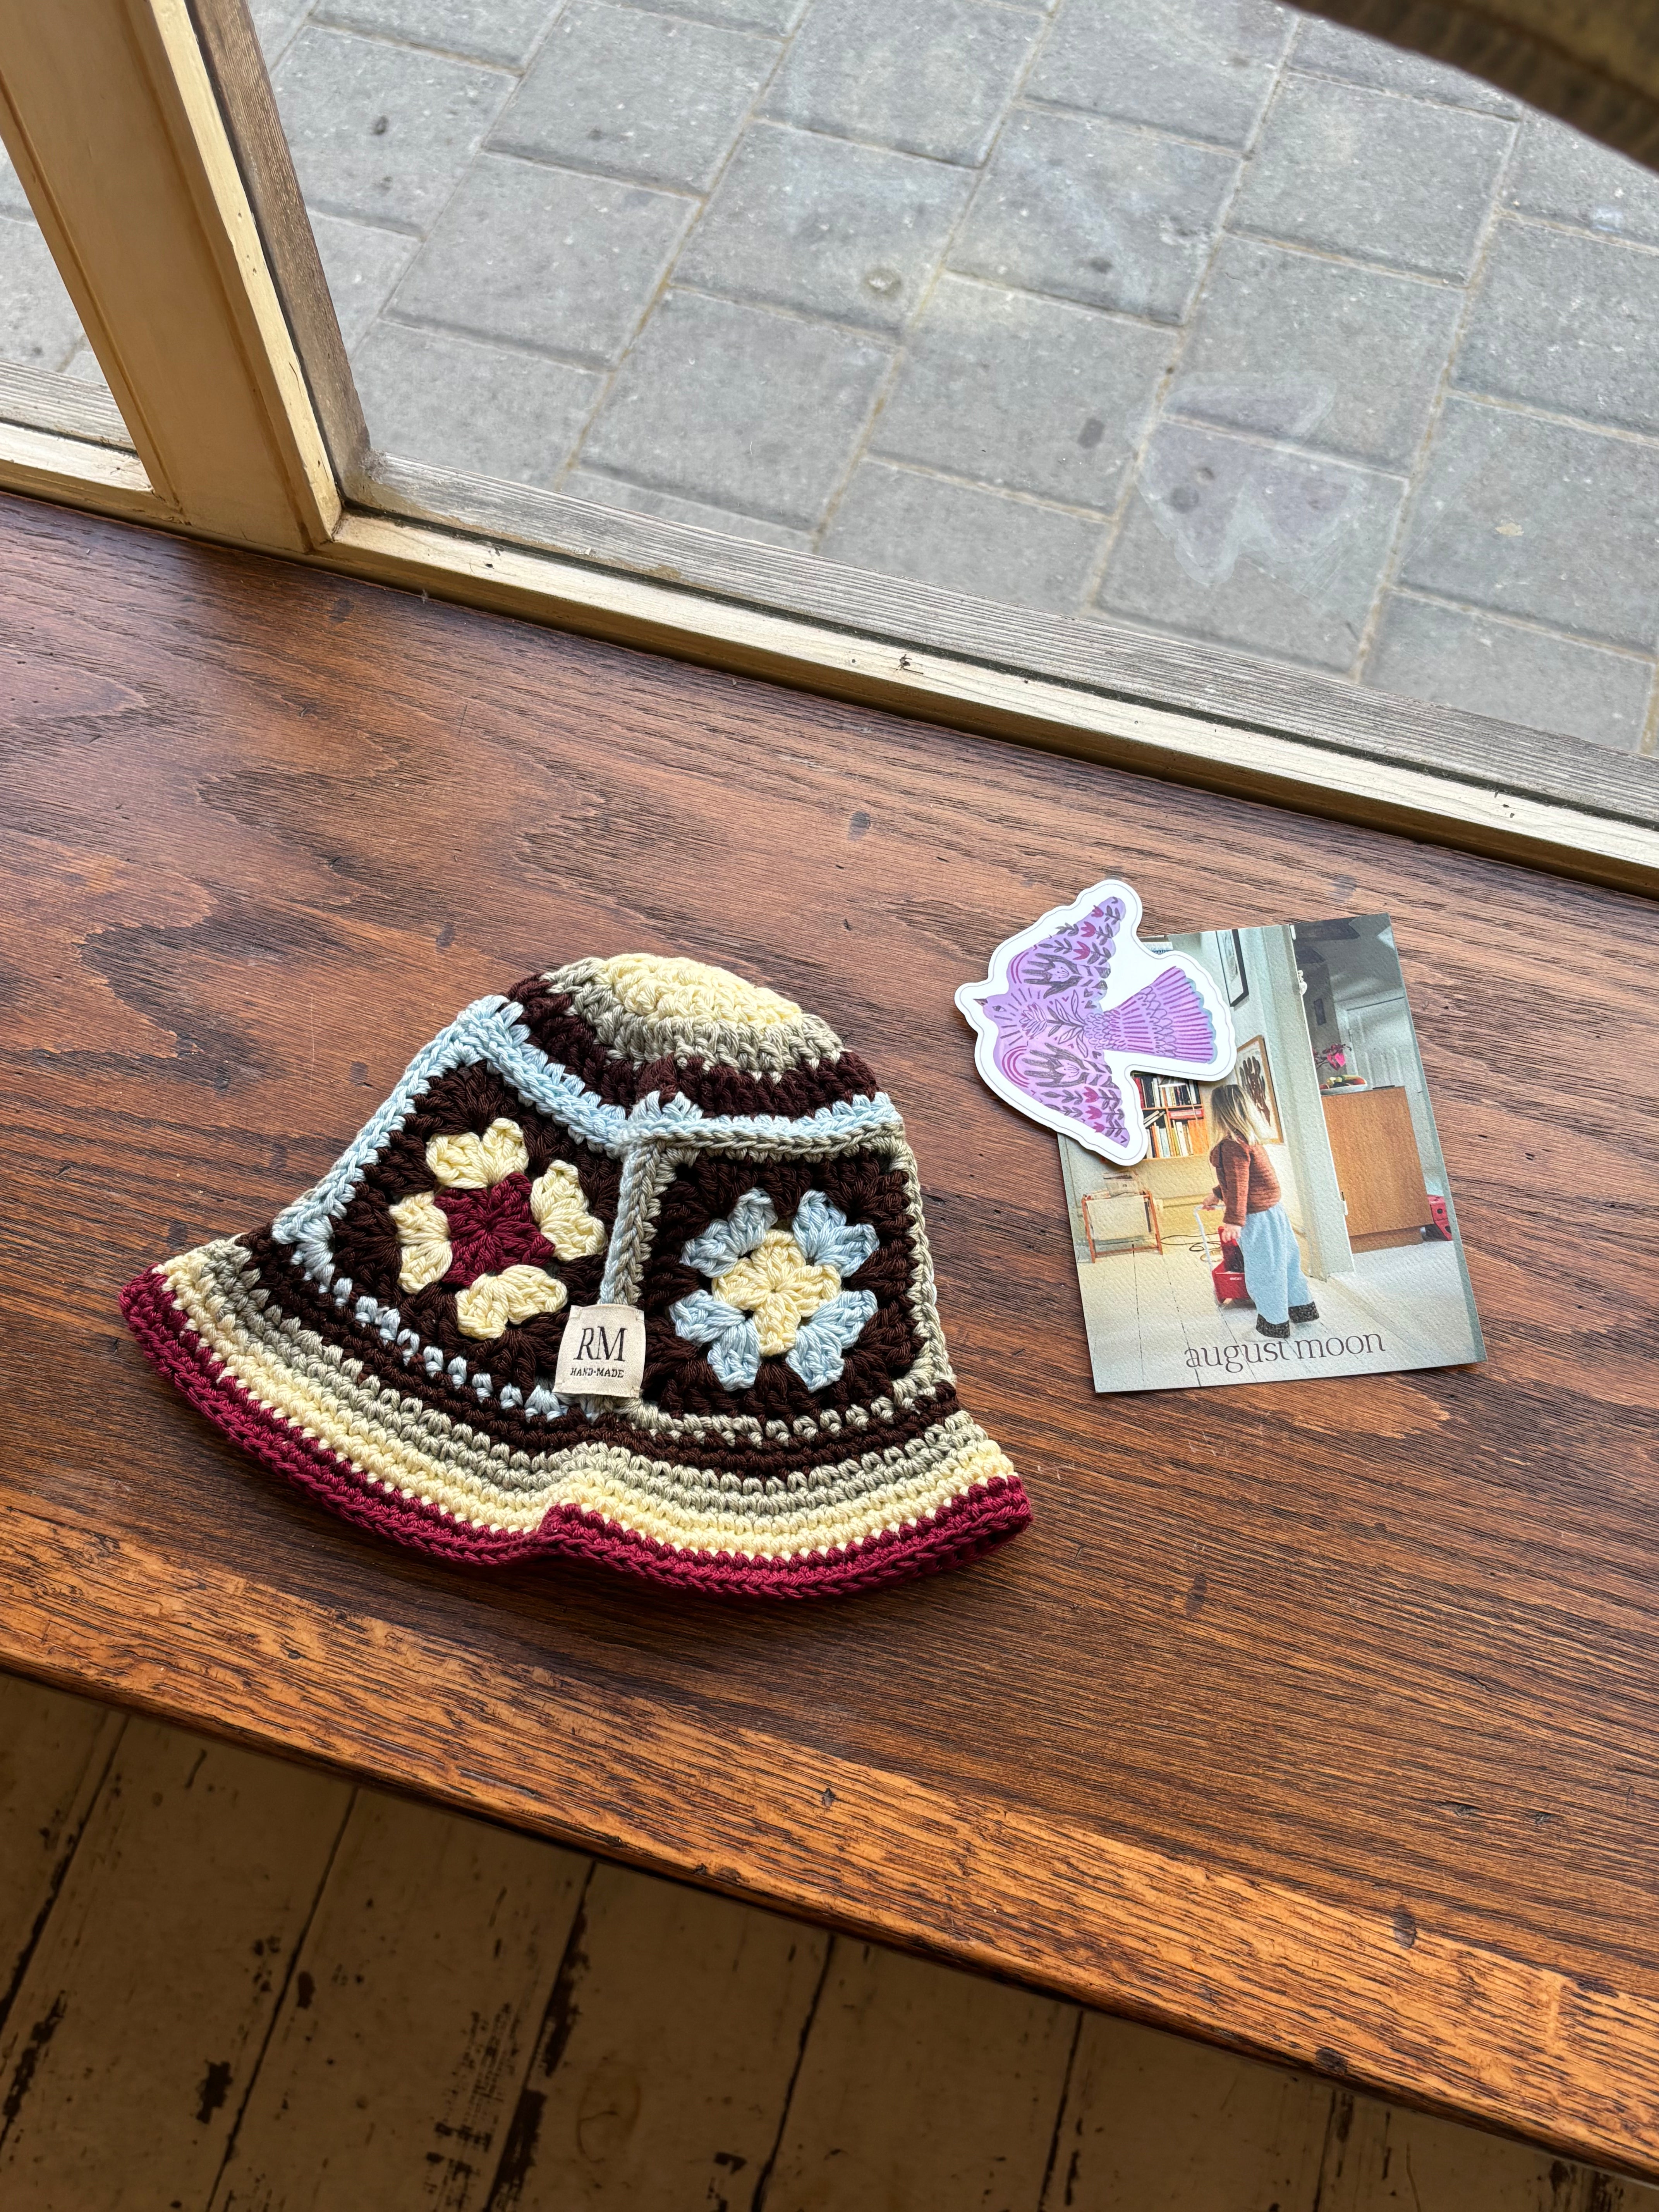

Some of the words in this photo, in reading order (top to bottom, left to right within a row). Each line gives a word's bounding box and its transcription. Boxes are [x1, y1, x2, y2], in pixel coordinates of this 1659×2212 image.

[573, 1326, 628, 1362] RM
[1184, 1340, 1290, 1373] august
[1295, 1332, 1386, 1359] moon
[570, 1367, 625, 1378] HAND-MADE
